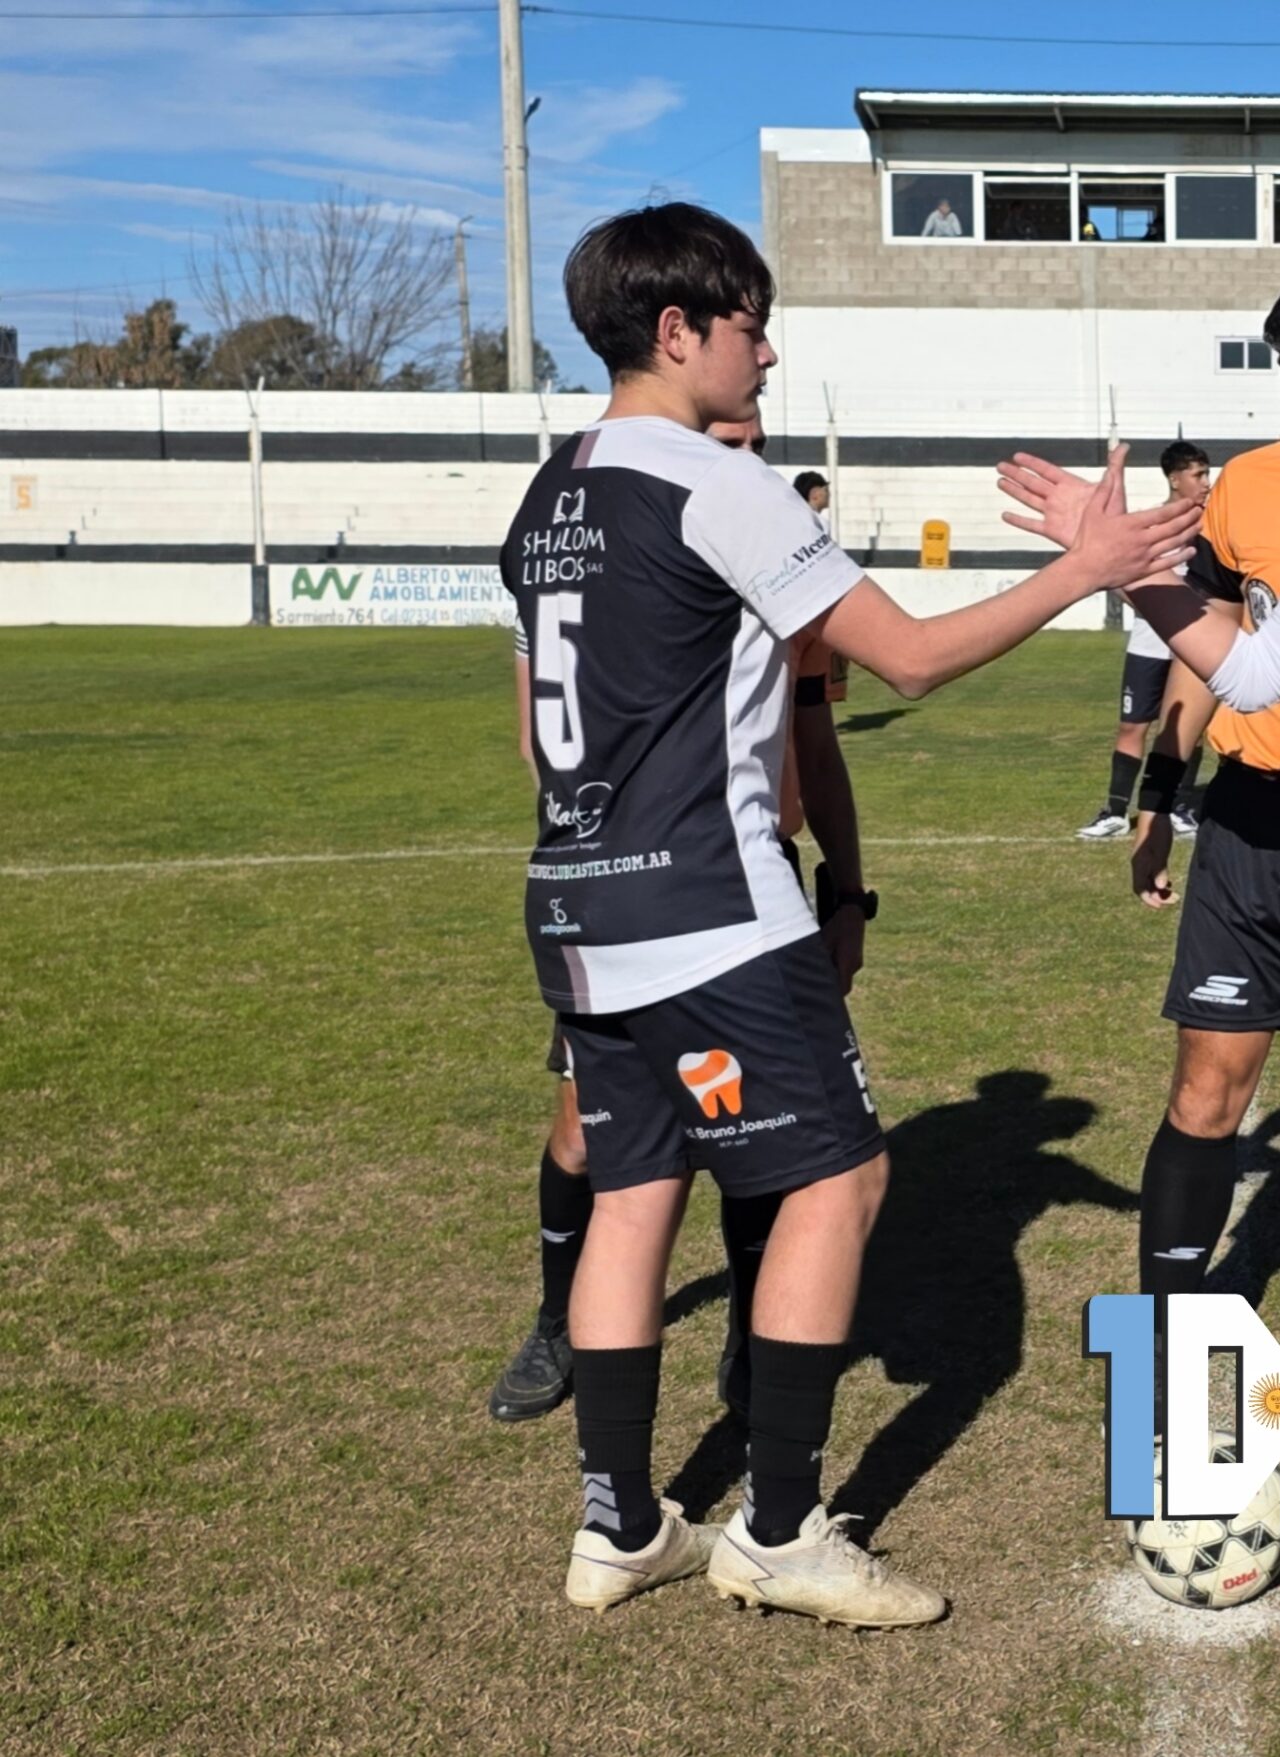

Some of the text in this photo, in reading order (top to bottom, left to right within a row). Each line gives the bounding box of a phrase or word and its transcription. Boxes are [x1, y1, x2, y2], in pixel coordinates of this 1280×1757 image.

[373, 568, 451, 584] ALBERTO
[522, 556, 586, 585] LIBOS
[347, 608, 375, 625] 764
[533, 590, 584, 773] 5
[695, 1125, 737, 1140] Bruno
[738, 1111, 797, 1134] Joaquín
